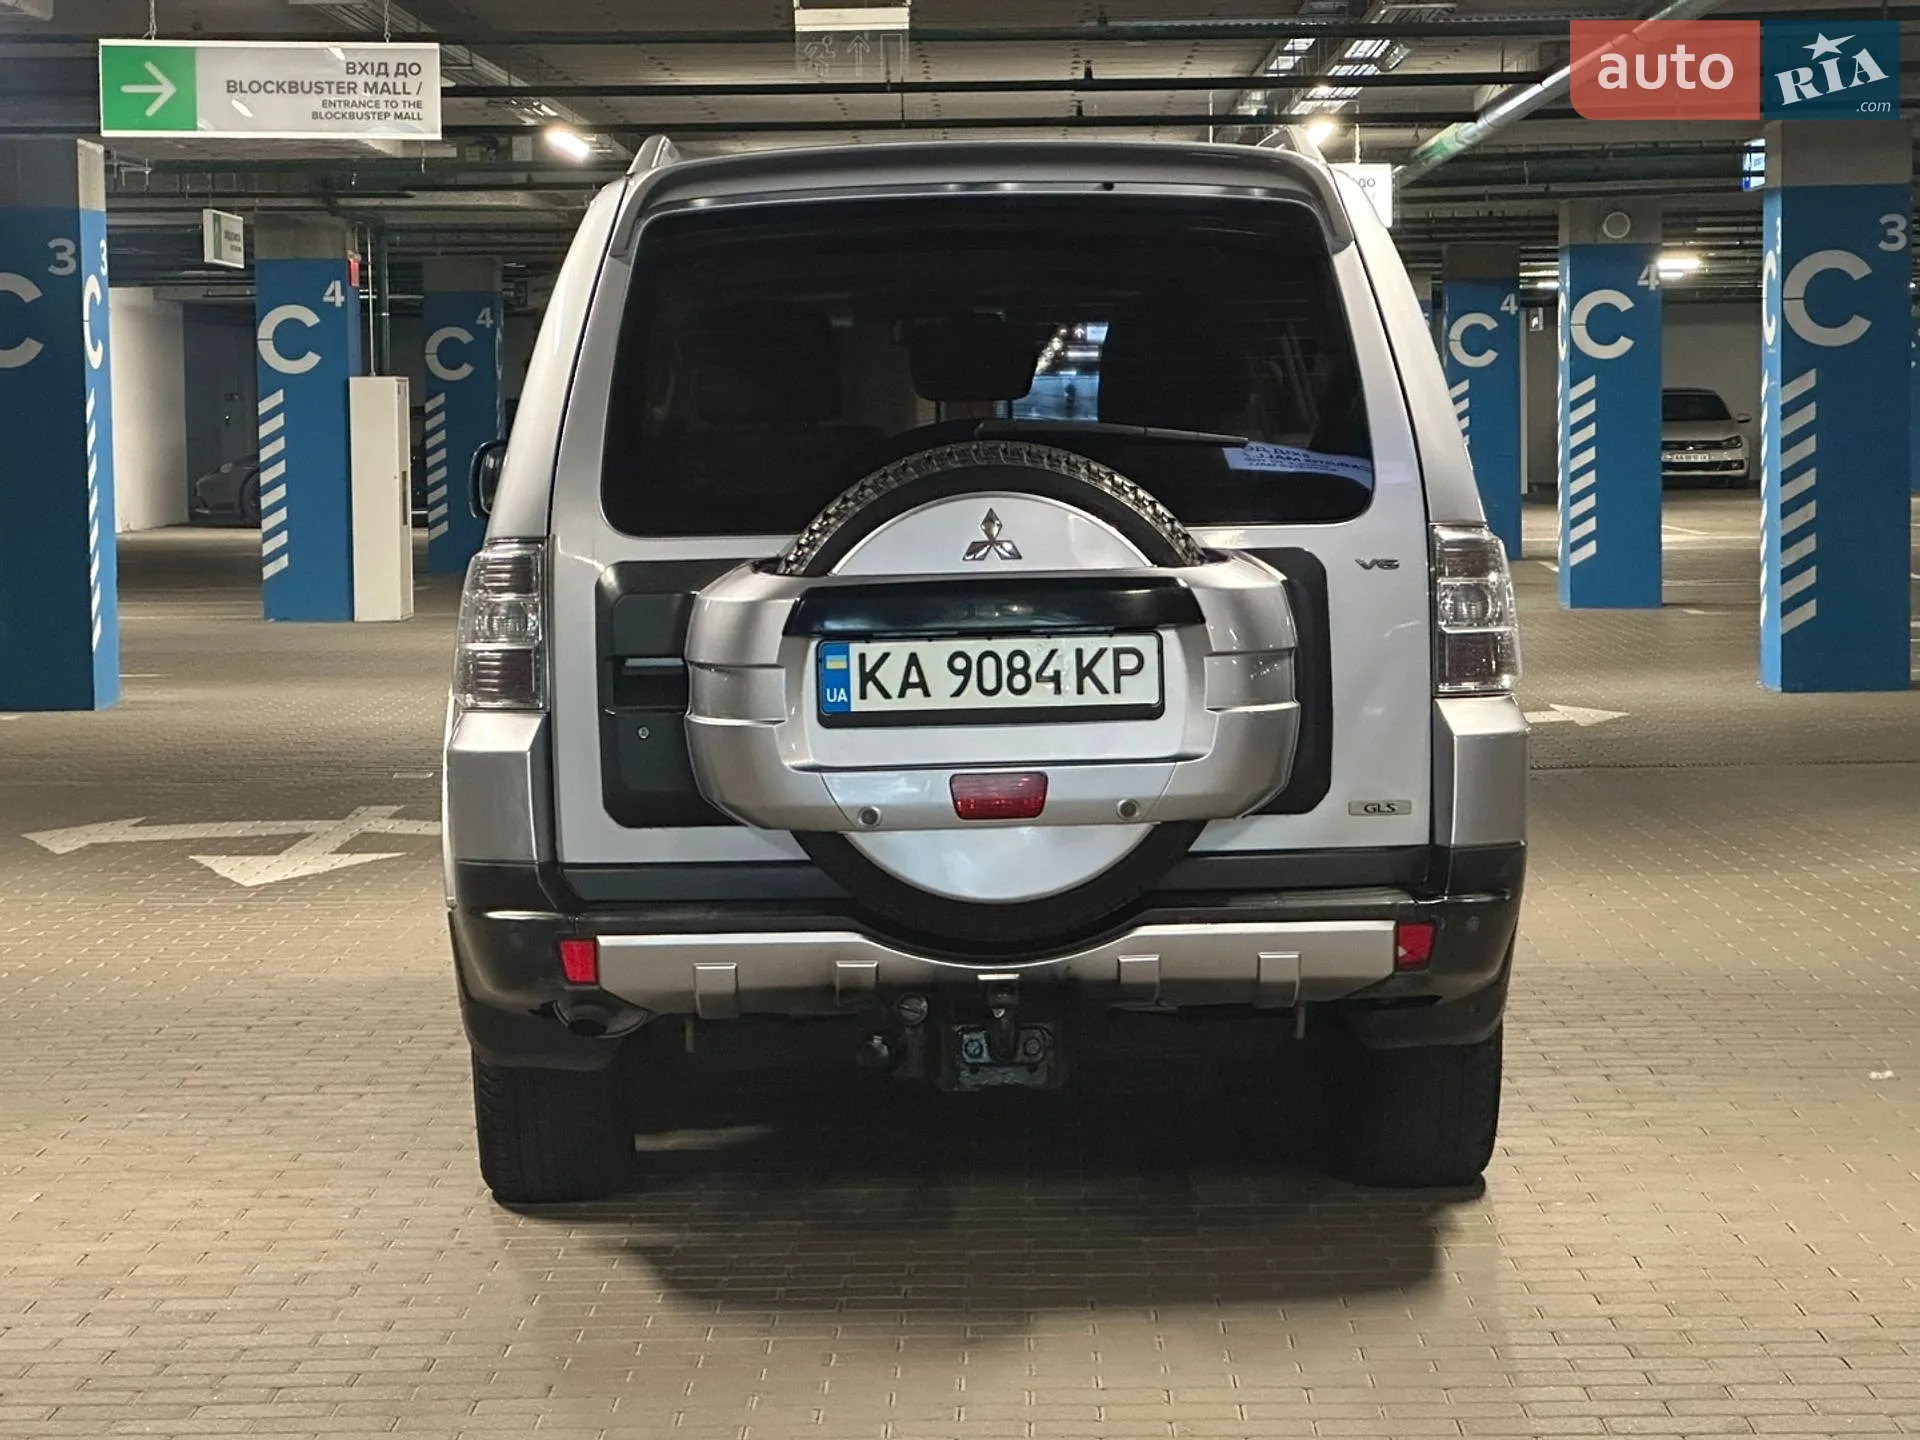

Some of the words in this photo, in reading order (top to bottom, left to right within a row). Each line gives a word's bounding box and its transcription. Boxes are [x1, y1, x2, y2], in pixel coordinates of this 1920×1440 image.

[345, 61, 390, 78] ВХІД
[394, 62, 422, 78] ДО
[225, 79, 358, 95] BLOCKBUSTER
[363, 81, 412, 96] MALL
[321, 99, 381, 109] ENTRANCE
[385, 100, 399, 109] TO
[402, 100, 423, 109] THE
[393, 111, 423, 121] MALL
[1878, 213, 1908, 252] 3
[47, 238, 77, 276] 3
[1637, 264, 1660, 290] 4
[323, 280, 345, 307] 4
[1500, 292, 1519, 315] 4
[1782, 249, 1873, 347] C
[476, 307, 494, 328] 4
[1570, 289, 1635, 360] C
[257, 304, 321, 374] C
[1448, 312, 1499, 368] C
[424, 326, 475, 381] C
[1354, 558, 1400, 570] V6
[858, 651, 932, 700] KA
[946, 648, 1062, 697] 9084
[1075, 645, 1145, 695] KP
[826, 687, 848, 703] UA
[1363, 803, 1397, 813] GLS
